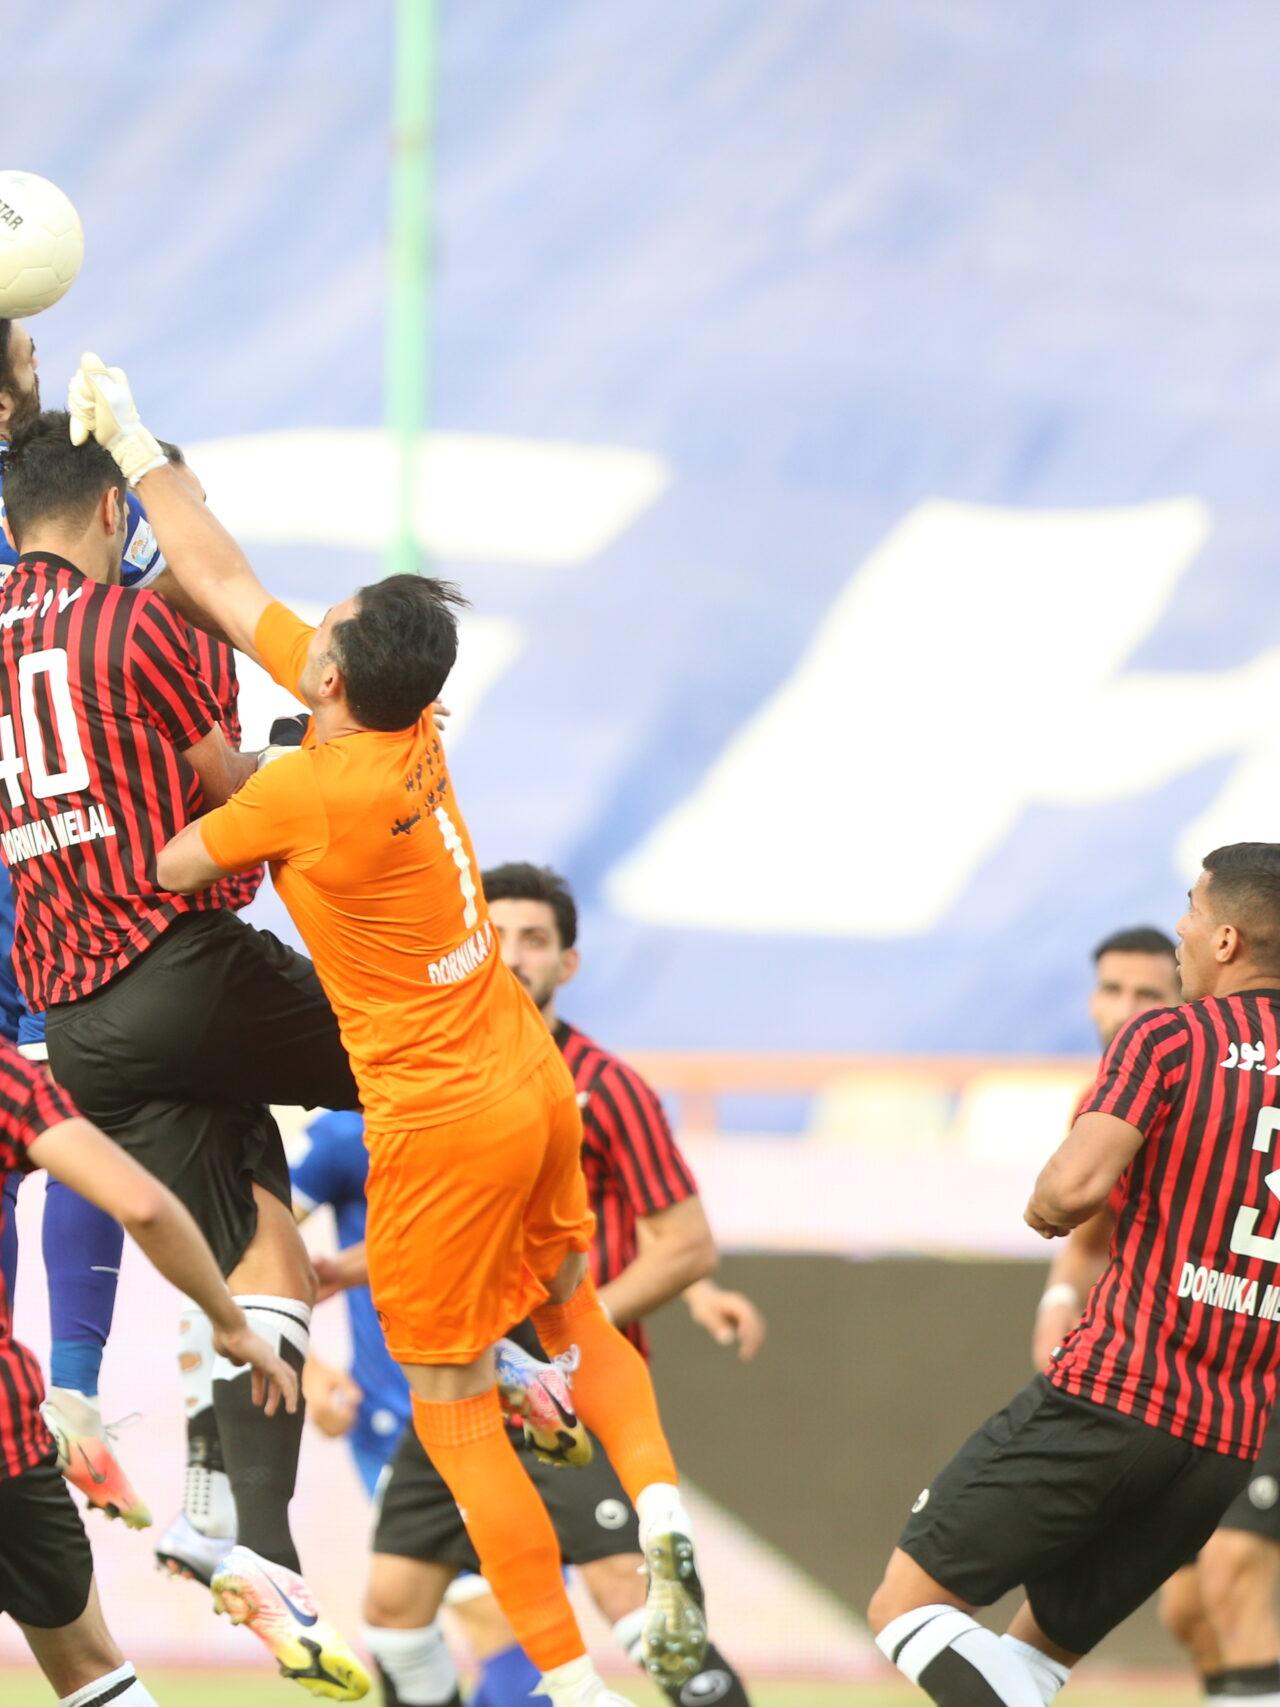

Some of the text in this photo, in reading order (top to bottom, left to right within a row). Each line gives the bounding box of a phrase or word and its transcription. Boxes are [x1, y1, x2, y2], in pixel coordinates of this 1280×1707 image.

[434, 806, 478, 929] 1
[427, 930, 489, 986] DORNIKA
[1176, 1261, 1259, 1317] DORNIKA
